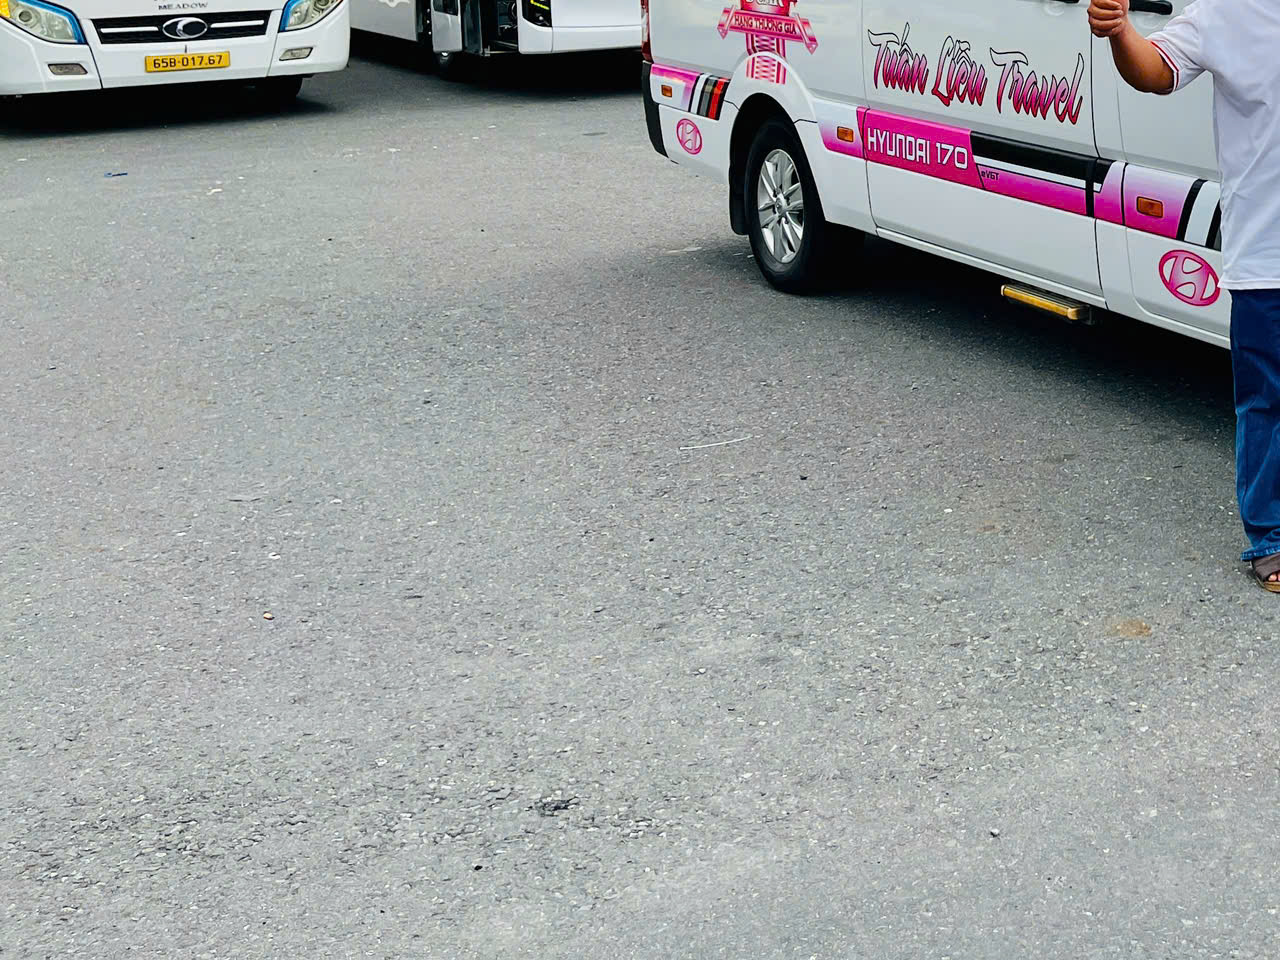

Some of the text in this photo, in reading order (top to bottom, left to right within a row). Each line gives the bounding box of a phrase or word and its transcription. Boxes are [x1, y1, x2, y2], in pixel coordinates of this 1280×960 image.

[158, 2, 208, 10] MEADOW
[867, 21, 930, 96] Tuấn
[990, 47, 1085, 125] Travel
[867, 127, 968, 170] HYUNDAI 170
